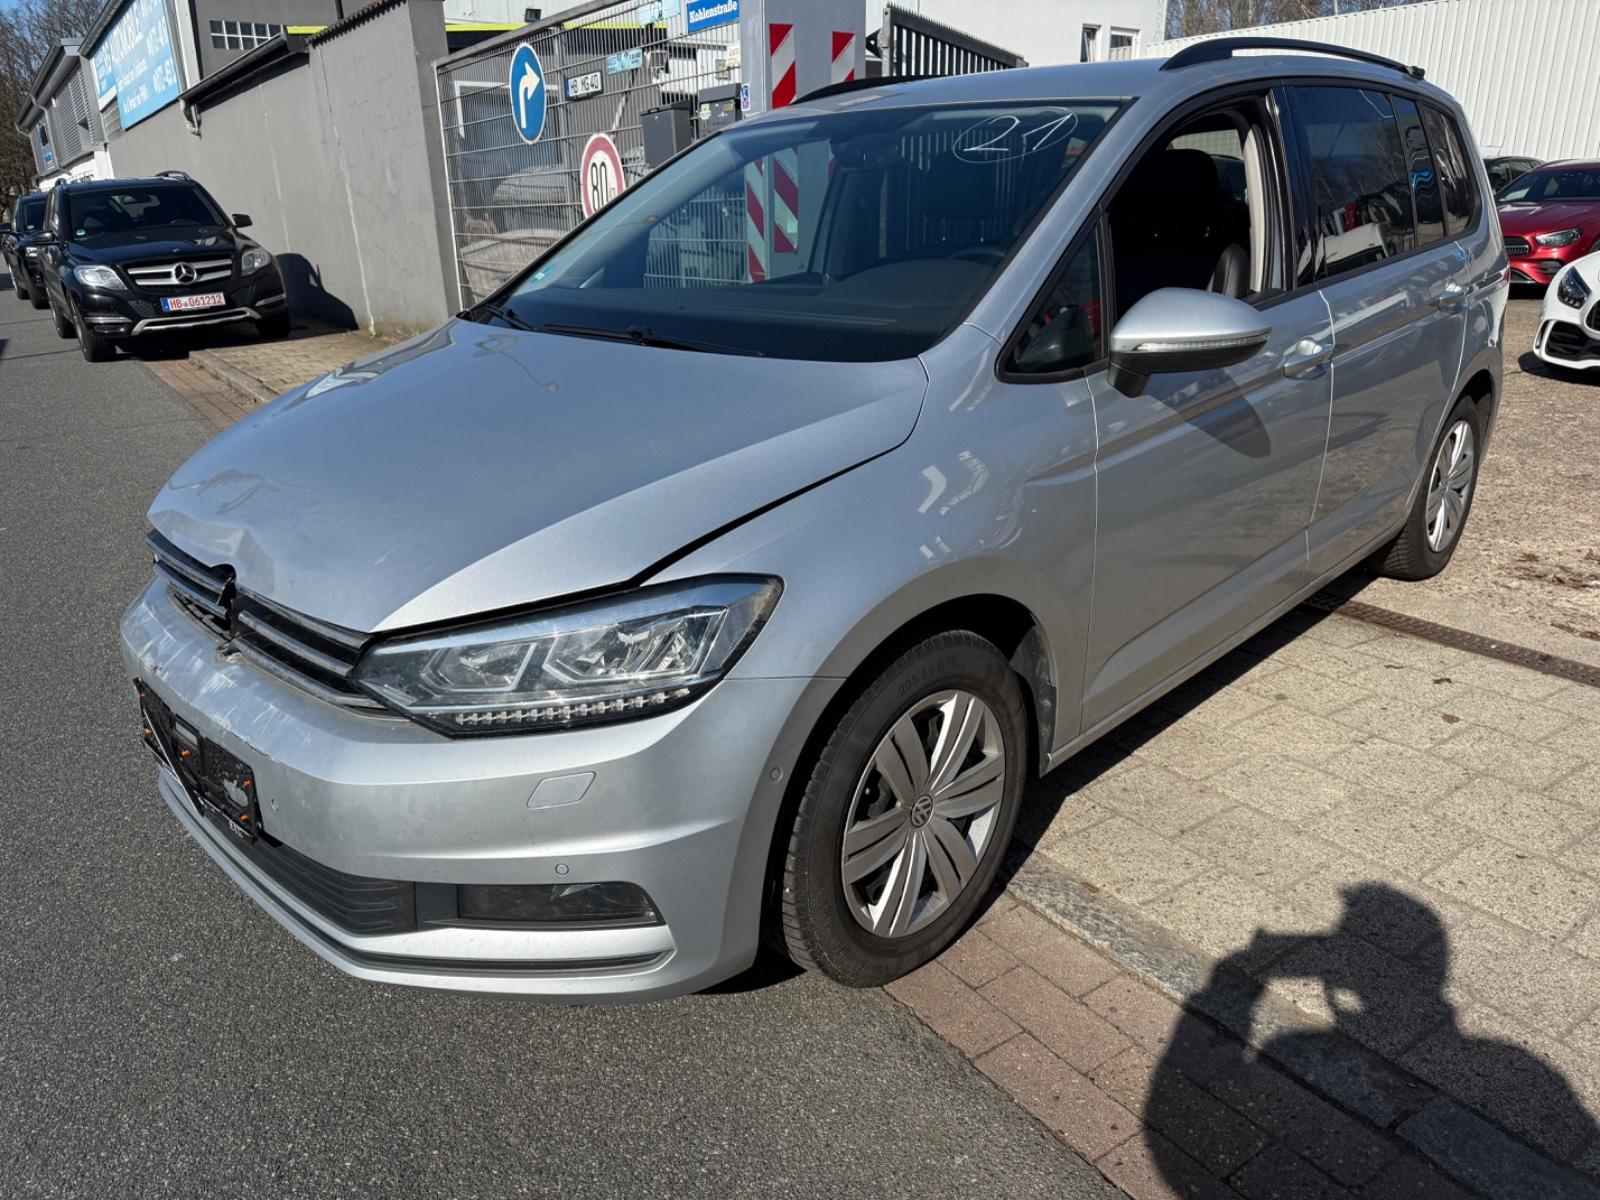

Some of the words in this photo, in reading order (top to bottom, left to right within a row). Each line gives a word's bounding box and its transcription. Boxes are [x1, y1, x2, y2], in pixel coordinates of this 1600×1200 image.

[689, 0, 738, 23] Kohlenstraße
[591, 161, 609, 212] 80
[170, 298, 182, 309] HB
[188, 294, 223, 307] 061212
